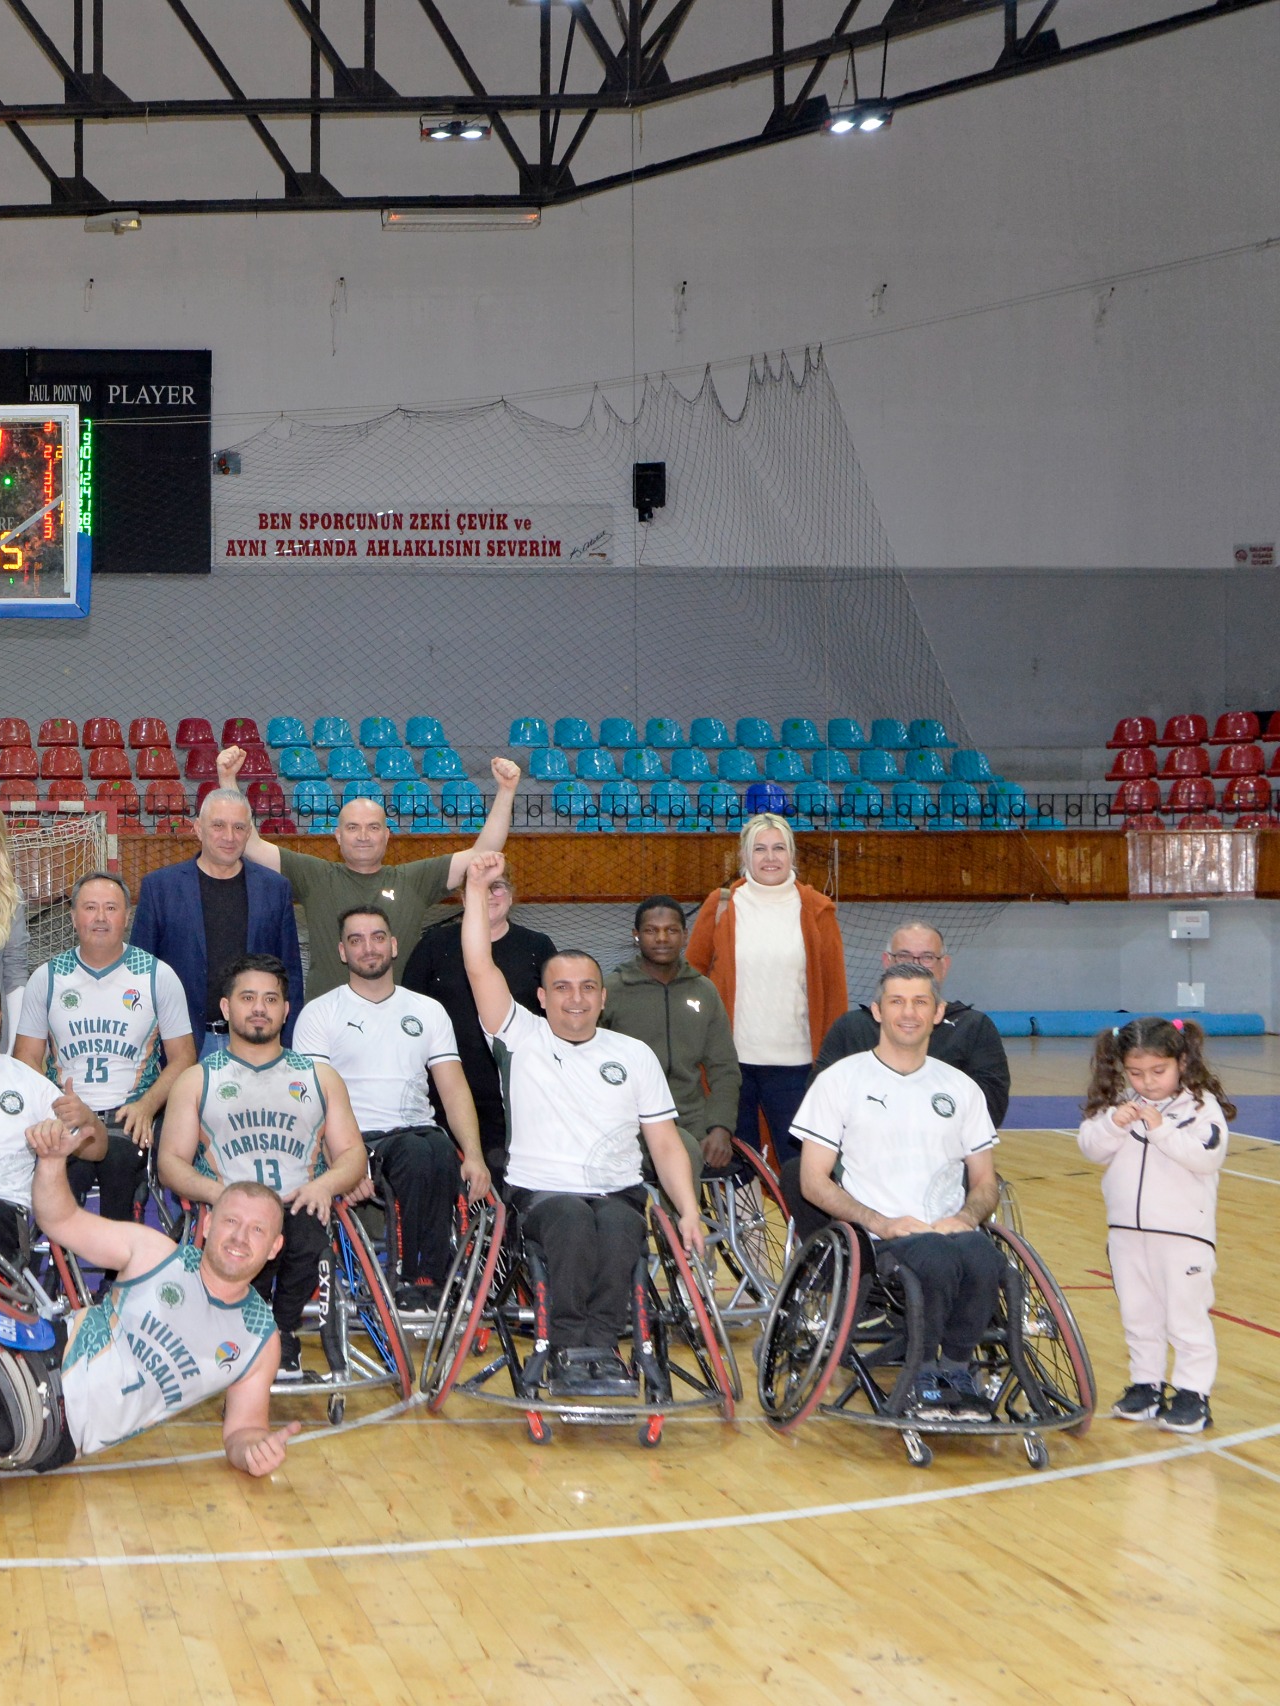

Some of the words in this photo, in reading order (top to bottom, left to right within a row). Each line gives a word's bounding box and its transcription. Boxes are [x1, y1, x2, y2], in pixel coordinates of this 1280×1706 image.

[29, 385, 50, 402] FAUL
[53, 385, 77, 402] POINT
[79, 385, 92, 402] NO
[108, 385, 197, 405] PLAYER
[80, 445, 92, 459] 10
[258, 513, 292, 530] BEN
[299, 513, 404, 530] SPORCUNUN
[410, 509, 451, 530] ZEKİ
[457, 509, 509, 535] ÇEVİK
[514, 519, 532, 530] ve
[226, 540, 267, 557] AYNI
[275, 540, 357, 557] ZAMANDA
[366, 540, 481, 557] AHLAKLISINI
[487, 535, 561, 557] SEVERİM
[68, 1017, 129, 1037] İYİLİKTE
[60, 1038, 138, 1061] YARIŞALIM
[84, 1057, 109, 1083] 15
[227, 1107, 297, 1132] İYİLİKTE
[221, 1132, 305, 1160] YARIŞALIM
[253, 1158, 283, 1192] 13
[318, 1260, 331, 1328] EXTRA
[140, 1310, 201, 1380] İYİLİKTE
[121, 1370, 146, 1396] 7
